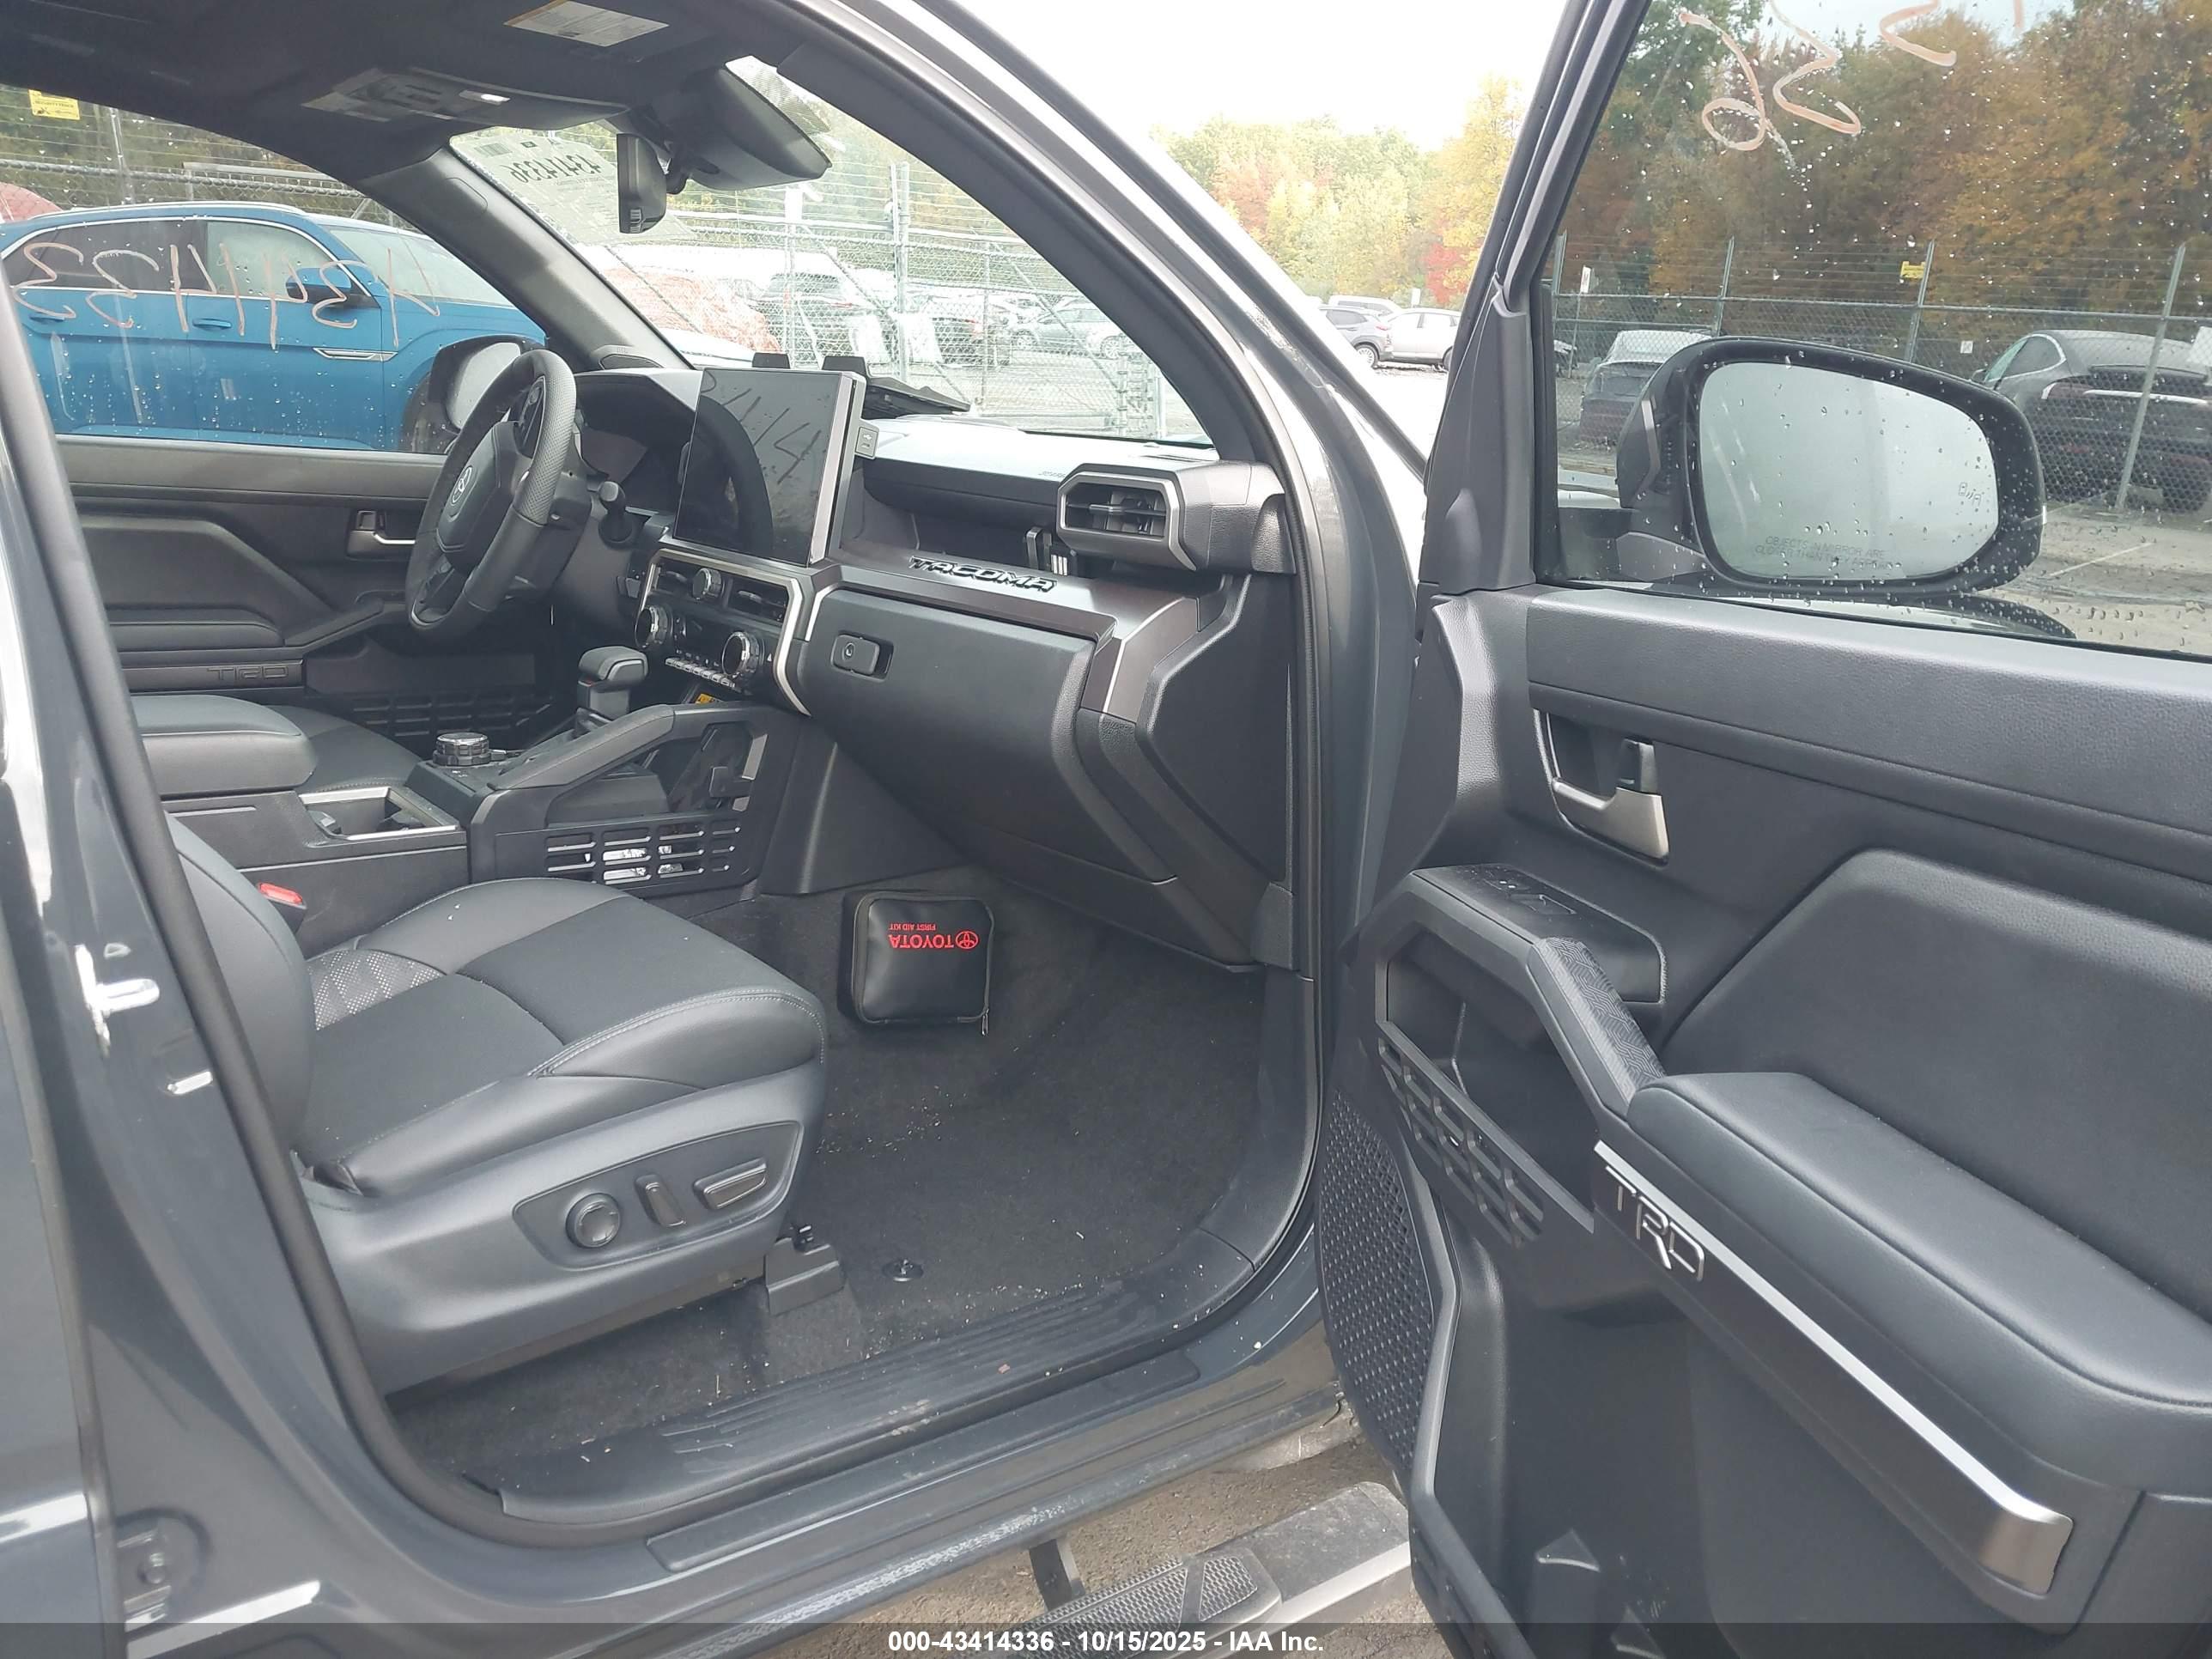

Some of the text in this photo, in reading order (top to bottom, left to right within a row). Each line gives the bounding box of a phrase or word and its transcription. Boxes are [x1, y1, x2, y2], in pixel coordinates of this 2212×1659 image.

[1865, 548, 1888, 558] ARE
[909, 556, 1058, 592] TACOMA
[207, 665, 289, 681] TRD
[889, 922, 902, 931] KIT
[888, 934, 954, 949] TOYOTA
[1605, 1165, 1705, 1281] TRD
